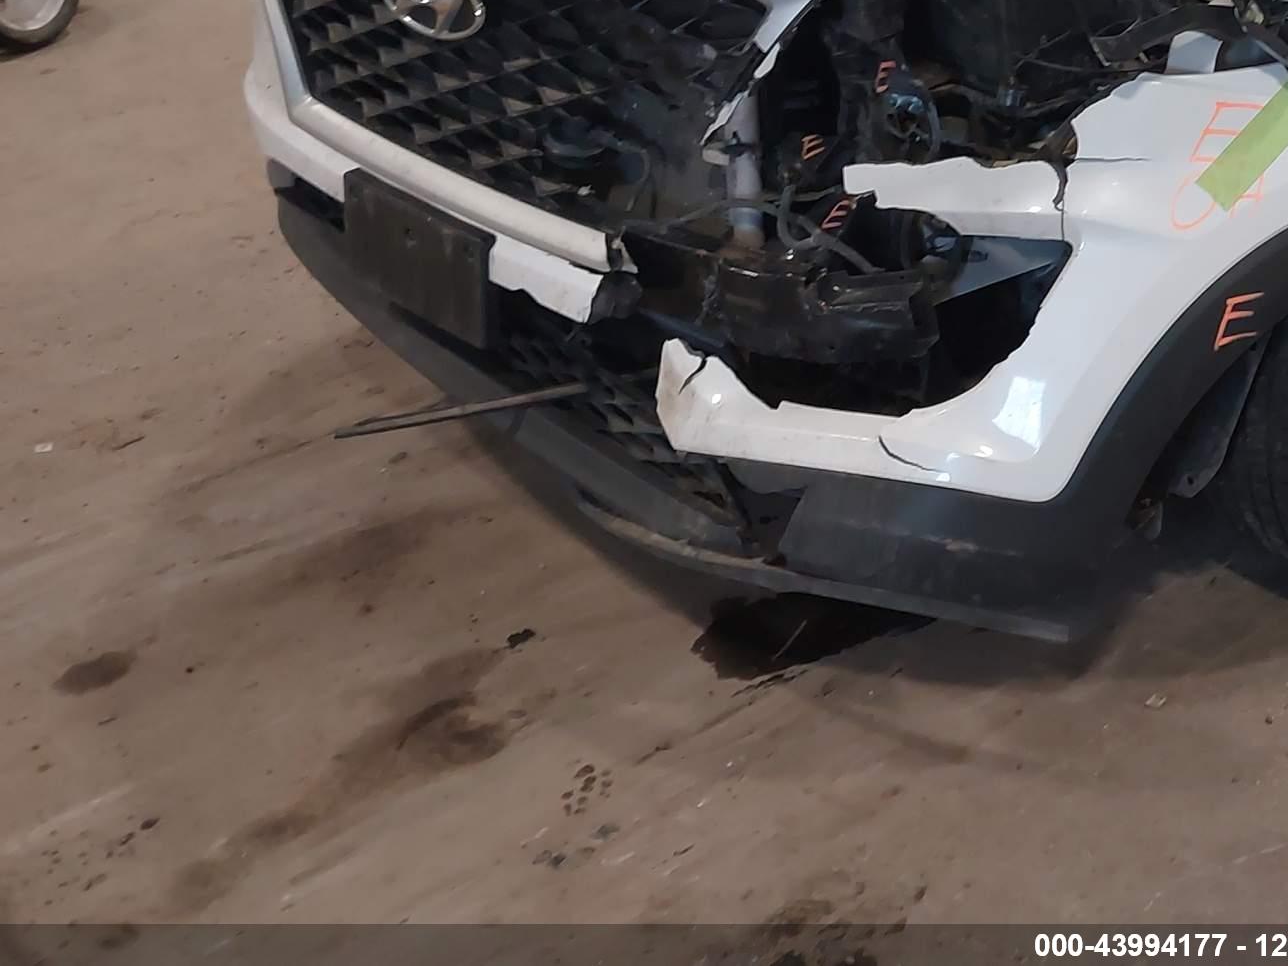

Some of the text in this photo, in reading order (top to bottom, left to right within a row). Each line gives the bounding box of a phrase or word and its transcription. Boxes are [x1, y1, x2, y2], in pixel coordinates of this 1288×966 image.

[875, 60, 897, 94] E
[801, 133, 825, 161] E
[821, 199, 851, 230] E
[1213, 291, 1265, 352] E
